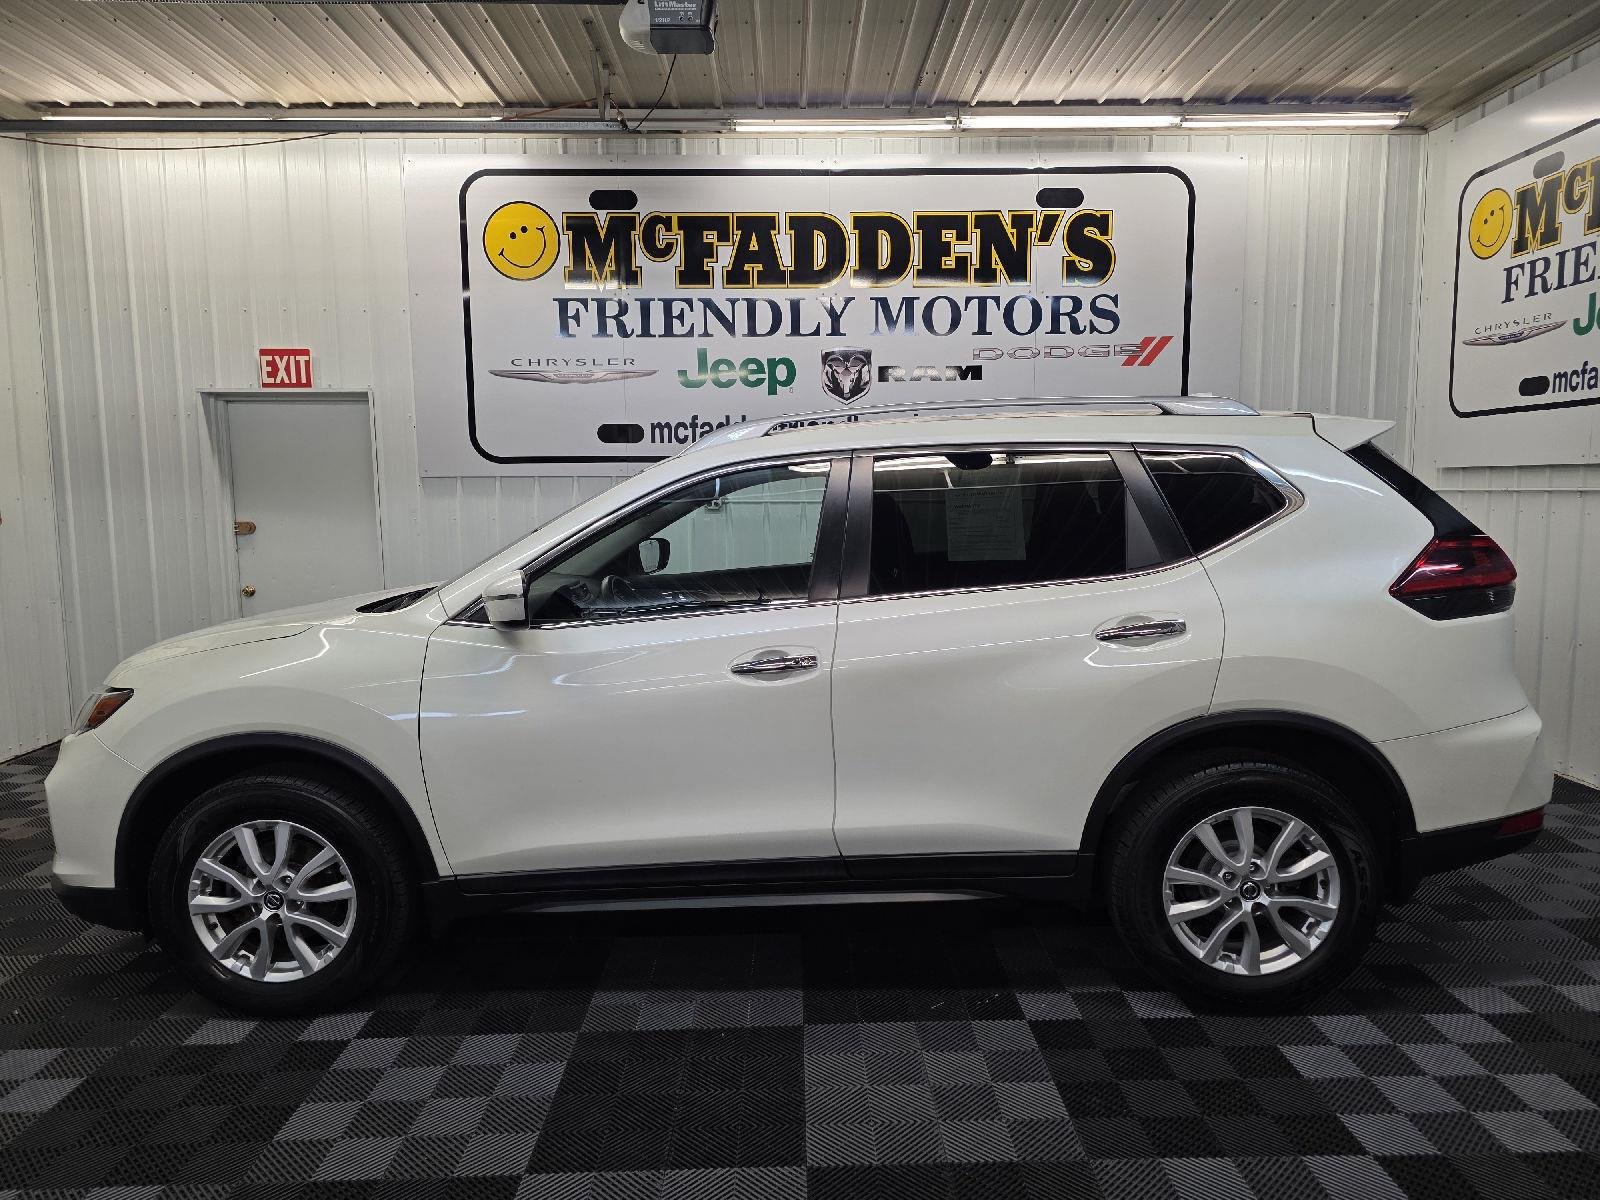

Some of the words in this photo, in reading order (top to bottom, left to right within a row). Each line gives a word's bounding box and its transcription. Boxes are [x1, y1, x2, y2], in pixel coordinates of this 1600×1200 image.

[1501, 241, 1600, 304] FRIE
[552, 296, 856, 339] FRIENDLY
[869, 294, 1120, 337] MOTORS
[1474, 312, 1552, 335] CHRYSLER
[1573, 292, 1600, 336] J
[510, 357, 636, 367] CHRYSLER
[972, 343, 1144, 361] DODGE
[260, 355, 310, 384] EXIT
[677, 347, 797, 396] Jeep
[877, 364, 983, 383] RAM
[1551, 361, 1599, 394] mcfa
